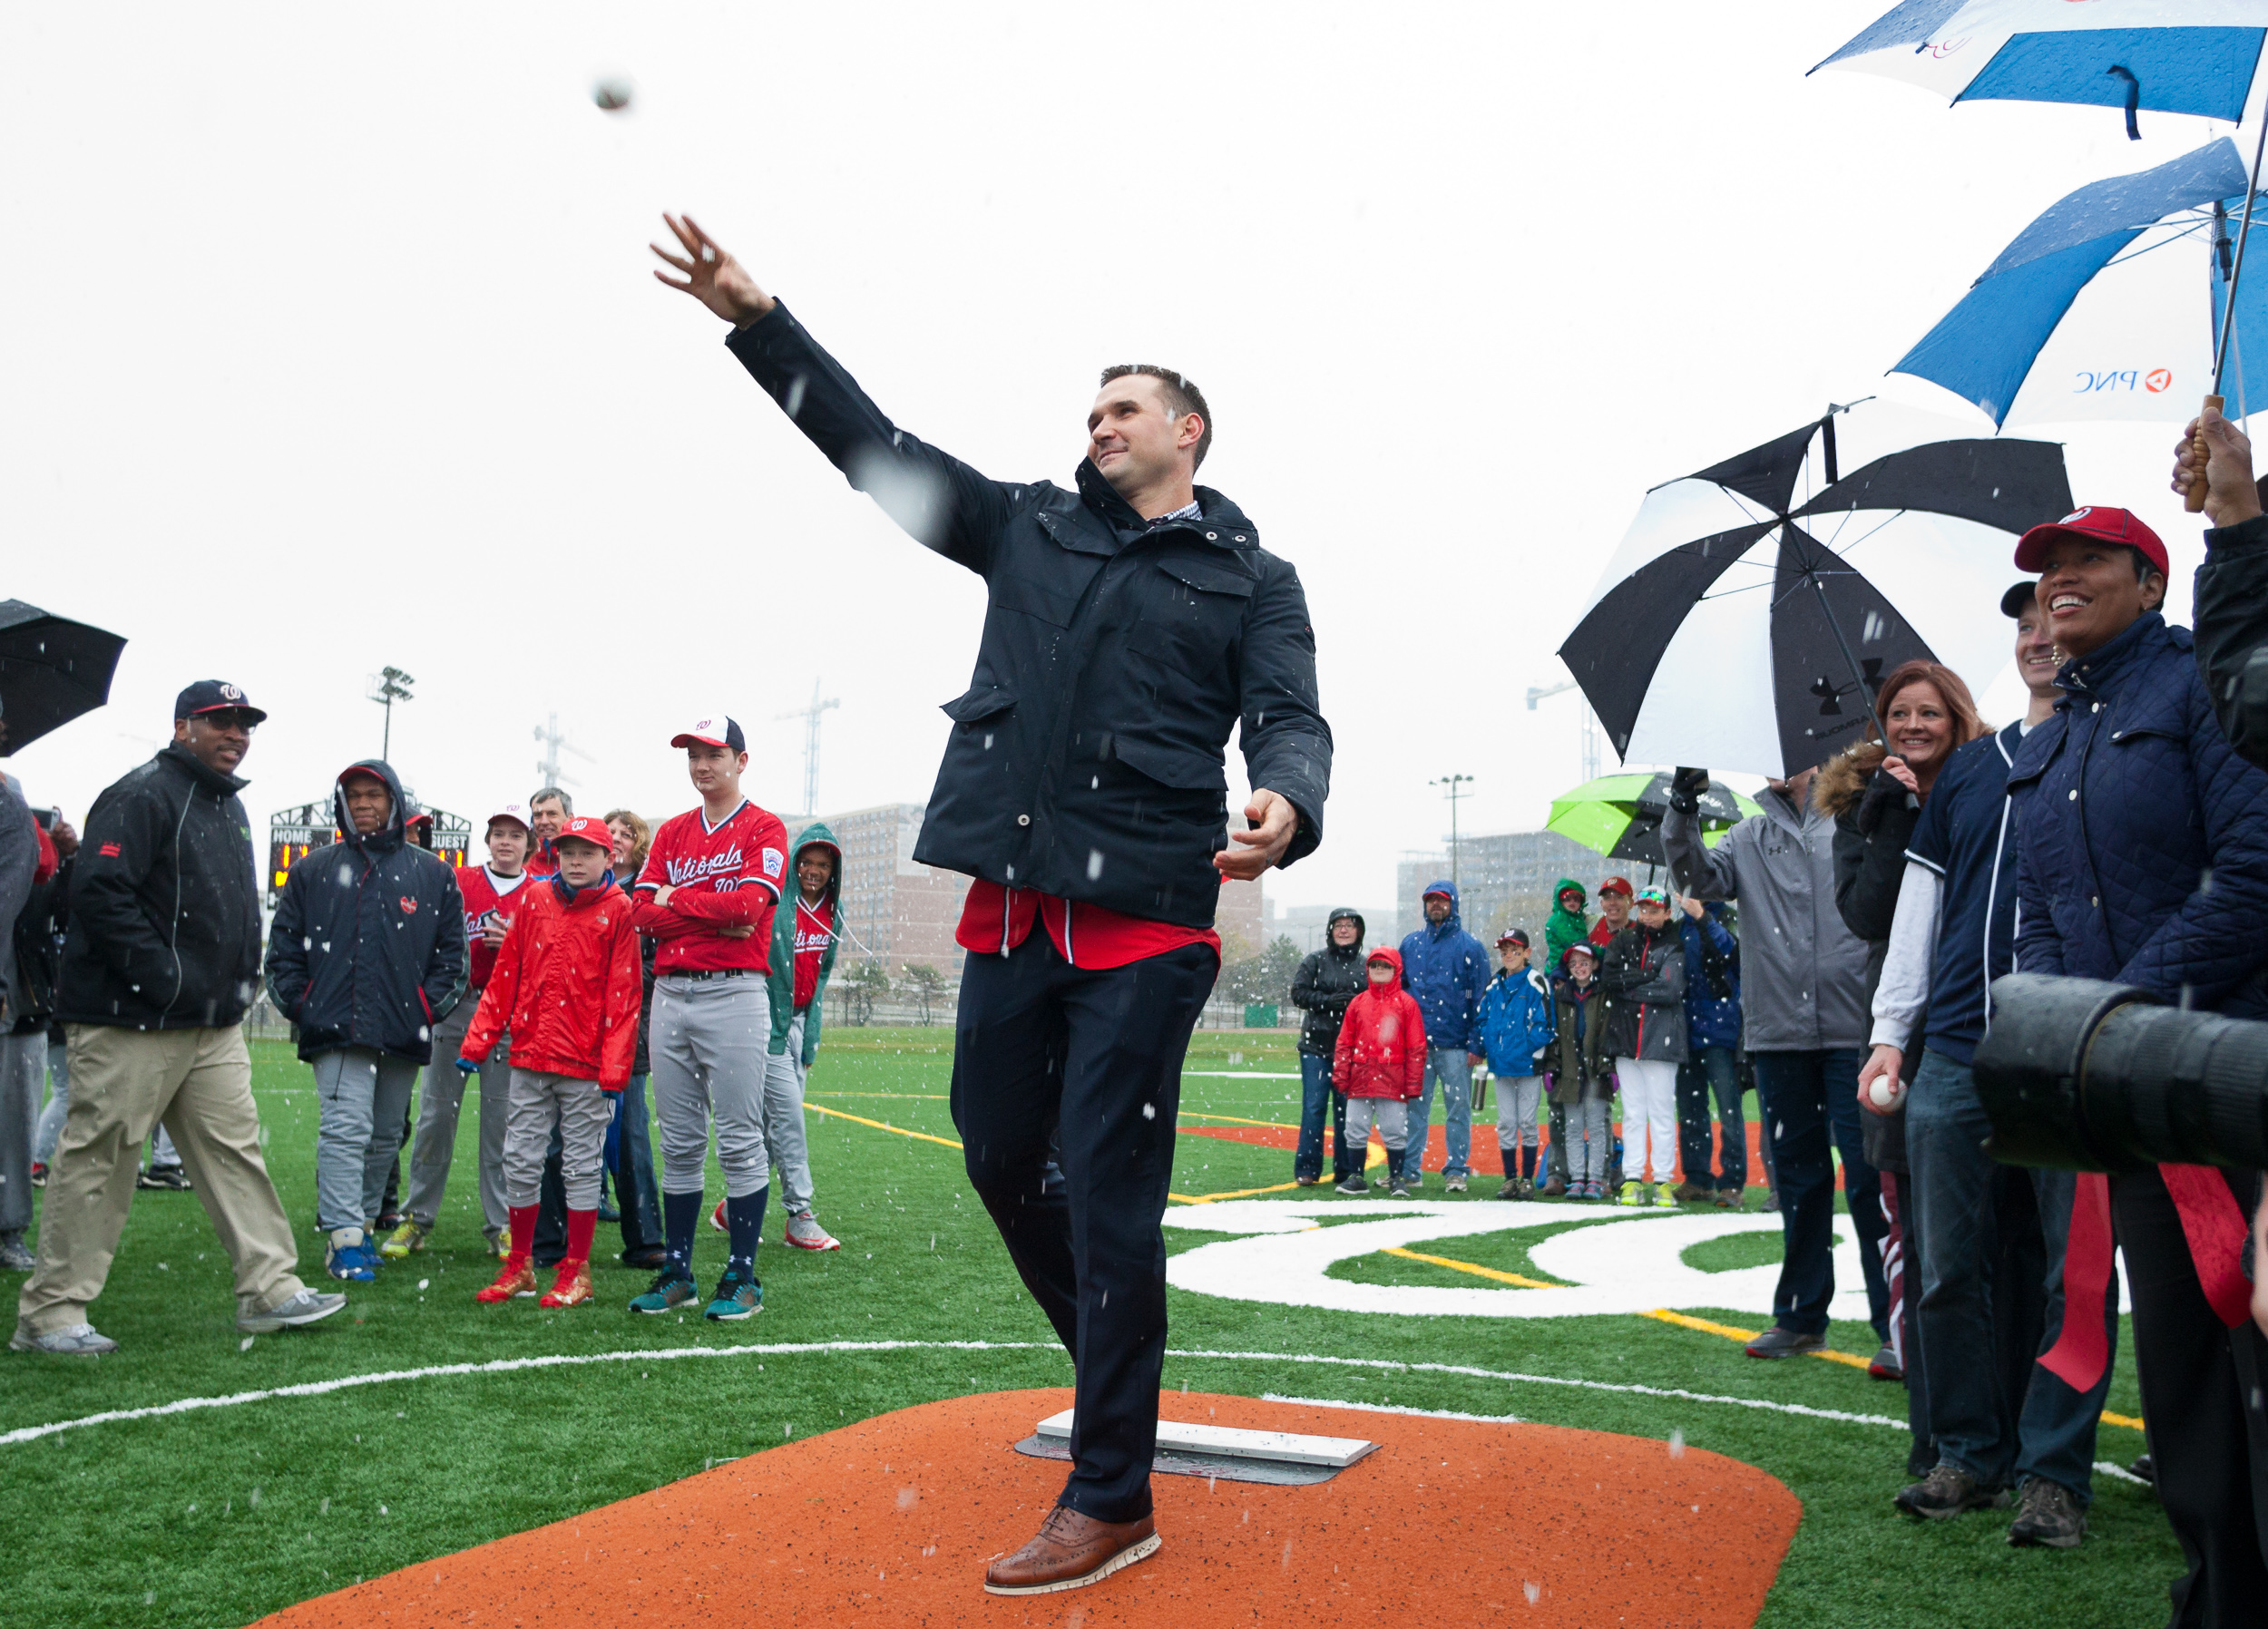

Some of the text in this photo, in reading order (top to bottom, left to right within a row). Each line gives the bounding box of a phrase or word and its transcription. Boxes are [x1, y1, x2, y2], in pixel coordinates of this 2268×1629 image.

[220, 684, 242, 700] W
[571, 819, 588, 831] W
[273, 829, 312, 844] HOME
[431, 834, 467, 849] GUEST
[666, 842, 743, 886] Nationals
[795, 929, 831, 947] tiona
